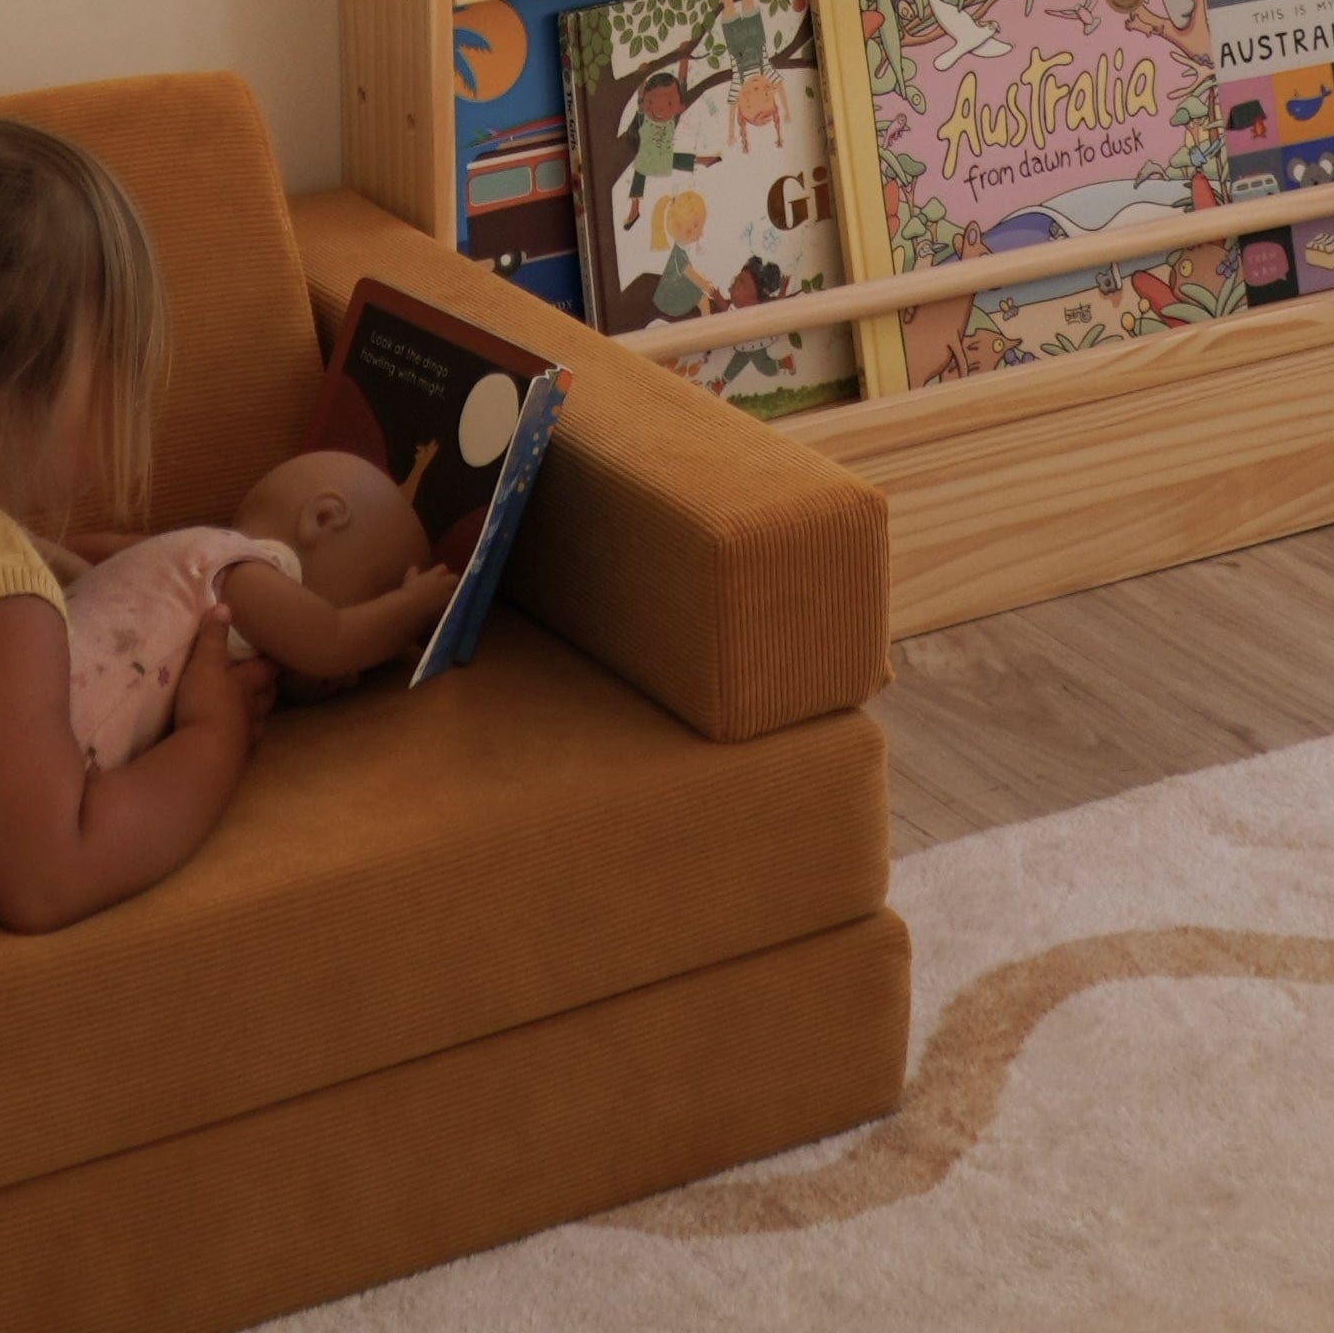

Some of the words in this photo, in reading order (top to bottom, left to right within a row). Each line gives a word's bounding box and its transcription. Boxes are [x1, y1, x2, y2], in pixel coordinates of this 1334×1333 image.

[1252, 9, 1285, 25] THIS
[1294, 4, 1307, 16] IS
[1316, 0, 1334, 13] MY
[936, 46, 1159, 180] Australia
[963, 164, 1016, 203] from
[1019, 149, 1072, 179] dawn
[1074, 137, 1095, 167] to
[1100, 127, 1145, 159] dusk
